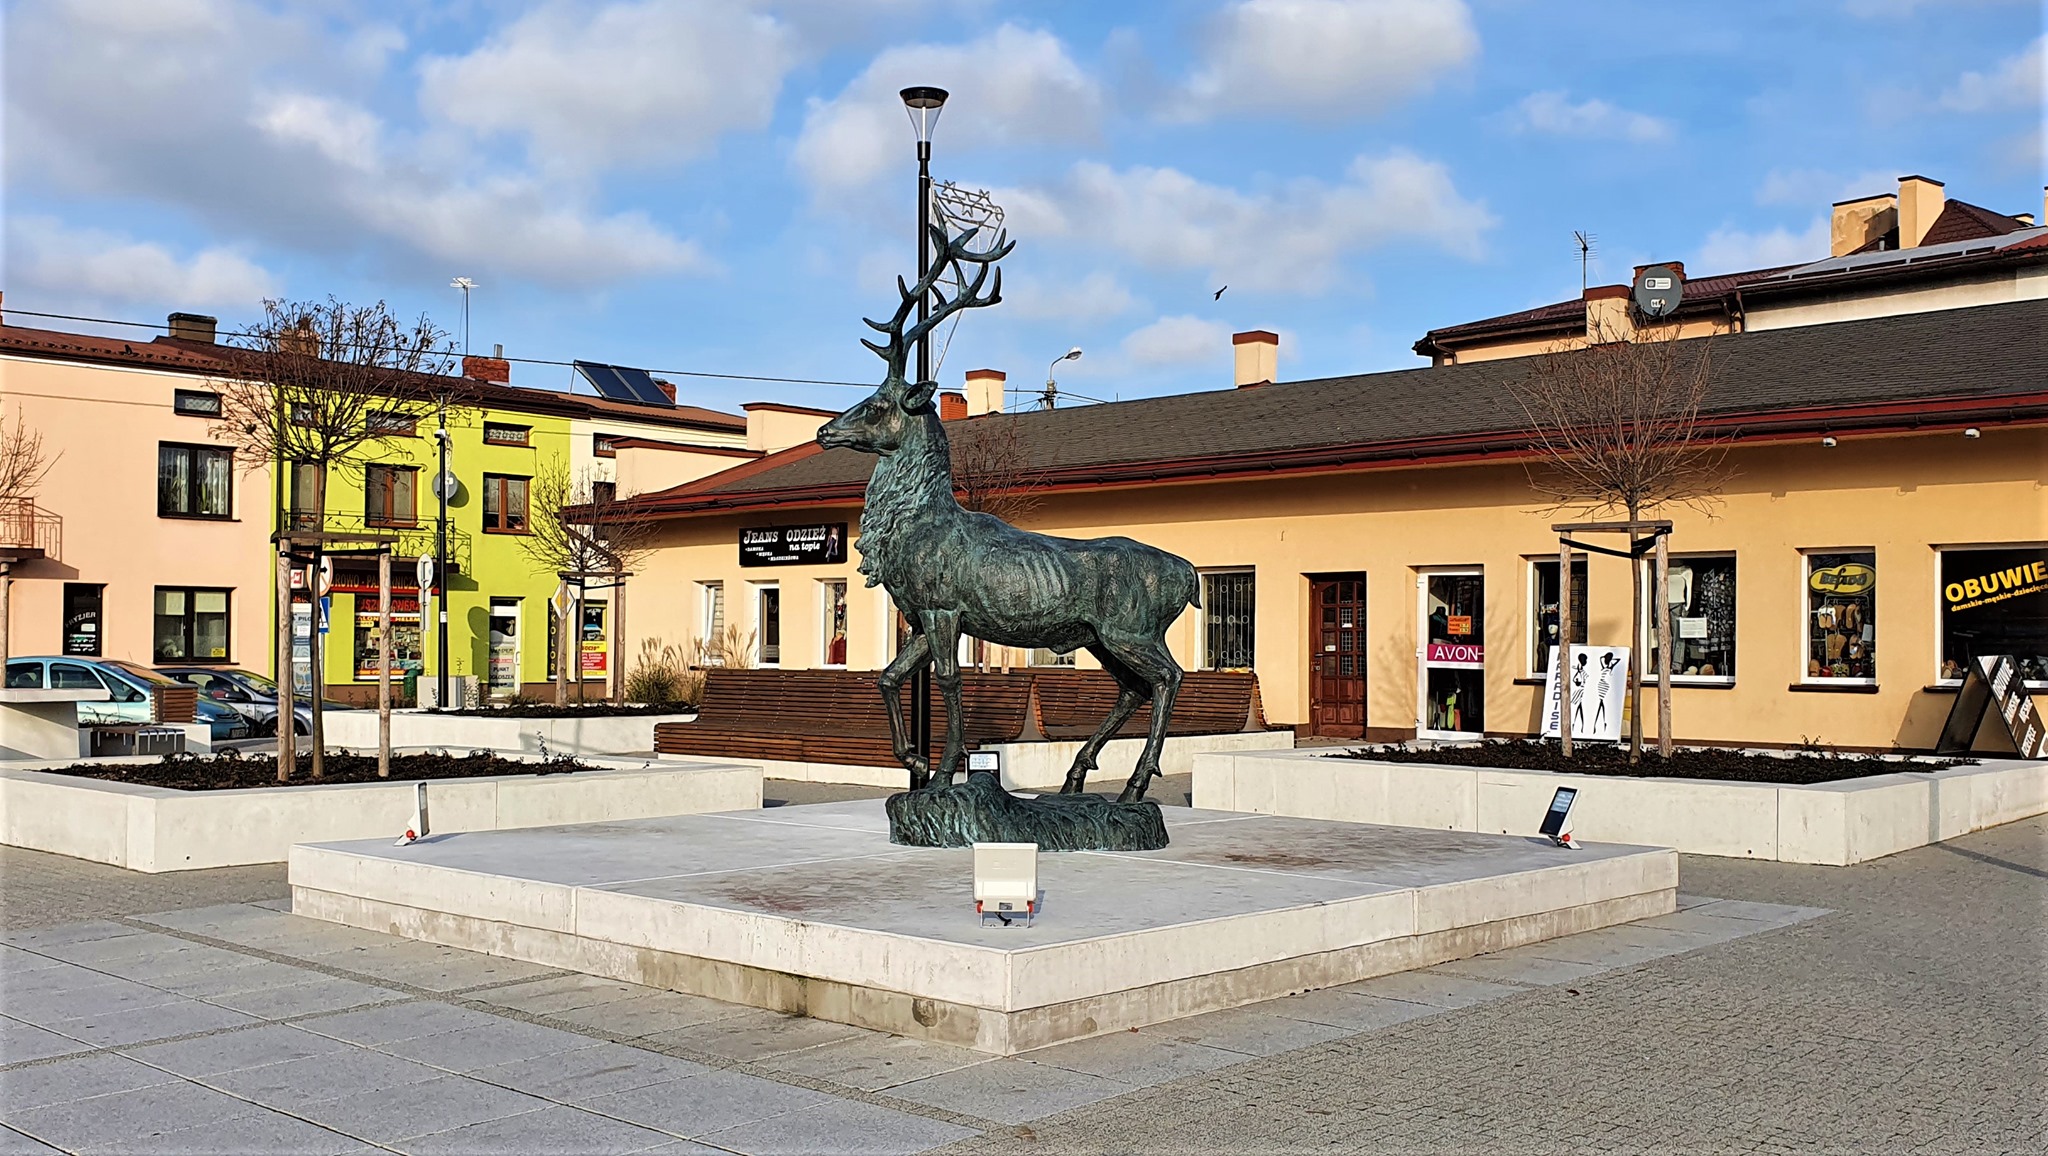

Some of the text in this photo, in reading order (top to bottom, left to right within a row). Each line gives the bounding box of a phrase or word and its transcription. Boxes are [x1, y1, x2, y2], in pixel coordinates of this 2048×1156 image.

[744, 525, 827, 544] JEANS ODZIEŻ
[789, 541, 821, 552] na topie
[1945, 560, 2048, 603] OBUWIE
[1434, 646, 1478, 661] AVON
